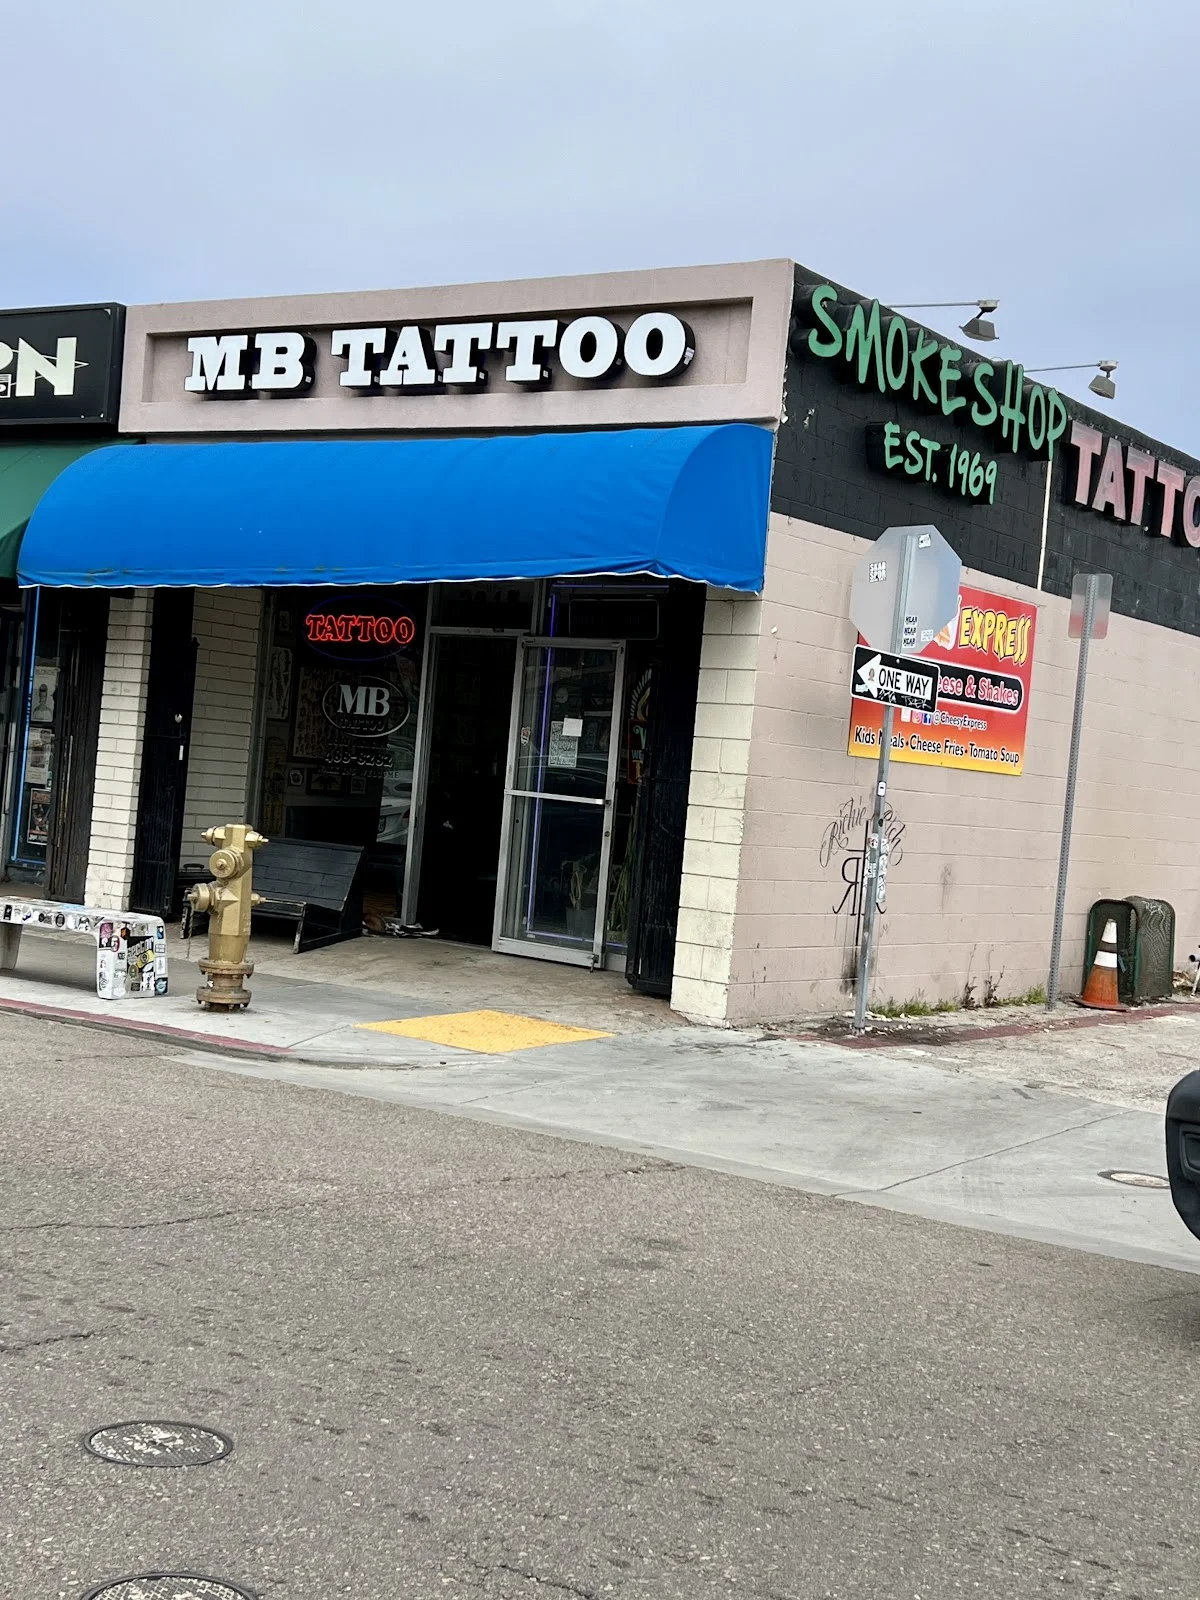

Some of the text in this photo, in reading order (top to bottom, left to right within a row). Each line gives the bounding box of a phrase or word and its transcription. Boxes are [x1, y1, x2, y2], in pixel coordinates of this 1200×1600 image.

[184, 312, 686, 391] MB TATTOO
[885, 421, 998, 505] EST. 1969
[306, 614, 415, 644] TATTOO
[960, 607, 1031, 665] EXPRESS
[878, 667, 902, 691] ONE
[905, 674, 930, 697] WAY
[965, 674, 977, 699] &
[978, 677, 1019, 706] Shakes
[337, 683, 391, 717] MB
[933, 710, 988, 732] @CheesyExpress
[854, 727, 876, 745] Kids
[910, 734, 942, 753] Cheese
[944, 739, 964, 756] Fries
[969, 743, 999, 761] Tomato
[1000, 747, 1020, 766] Soup
